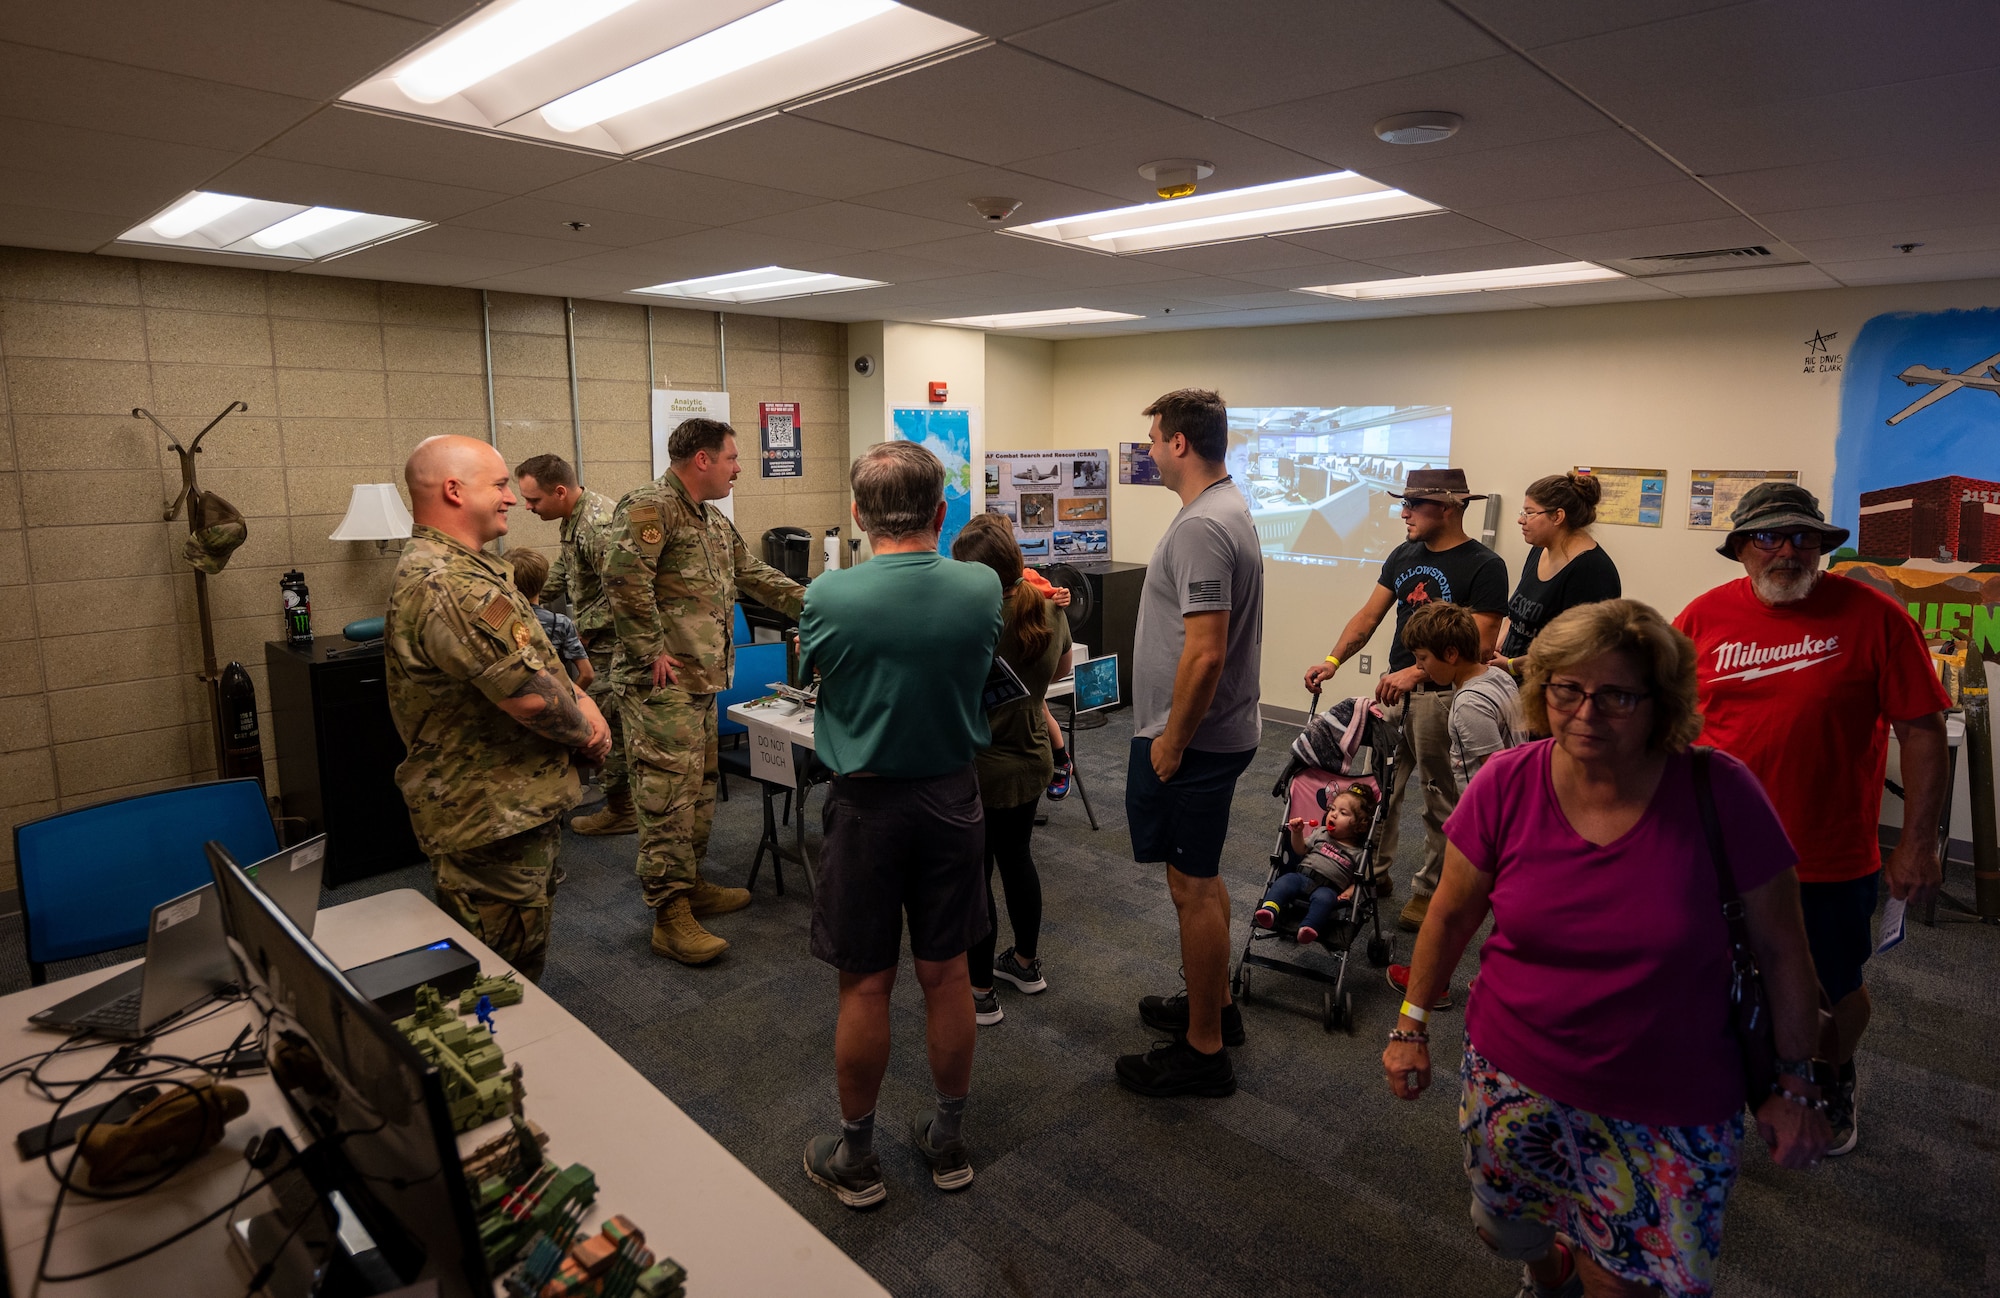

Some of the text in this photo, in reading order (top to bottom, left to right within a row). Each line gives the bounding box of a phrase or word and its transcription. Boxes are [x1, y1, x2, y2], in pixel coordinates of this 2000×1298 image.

[1820, 354, 1843, 364] DAVIS
[1819, 364, 1842, 373] CLARK
[674, 398, 703, 407] Analytic
[1395, 565, 1452, 605] ELLOWSTONE
[1510, 593, 1544, 621] ESSED
[1711, 634, 1839, 673] Milwaukee
[758, 736, 784, 751] DO NOT
[760, 751, 785, 767] TOUCH
